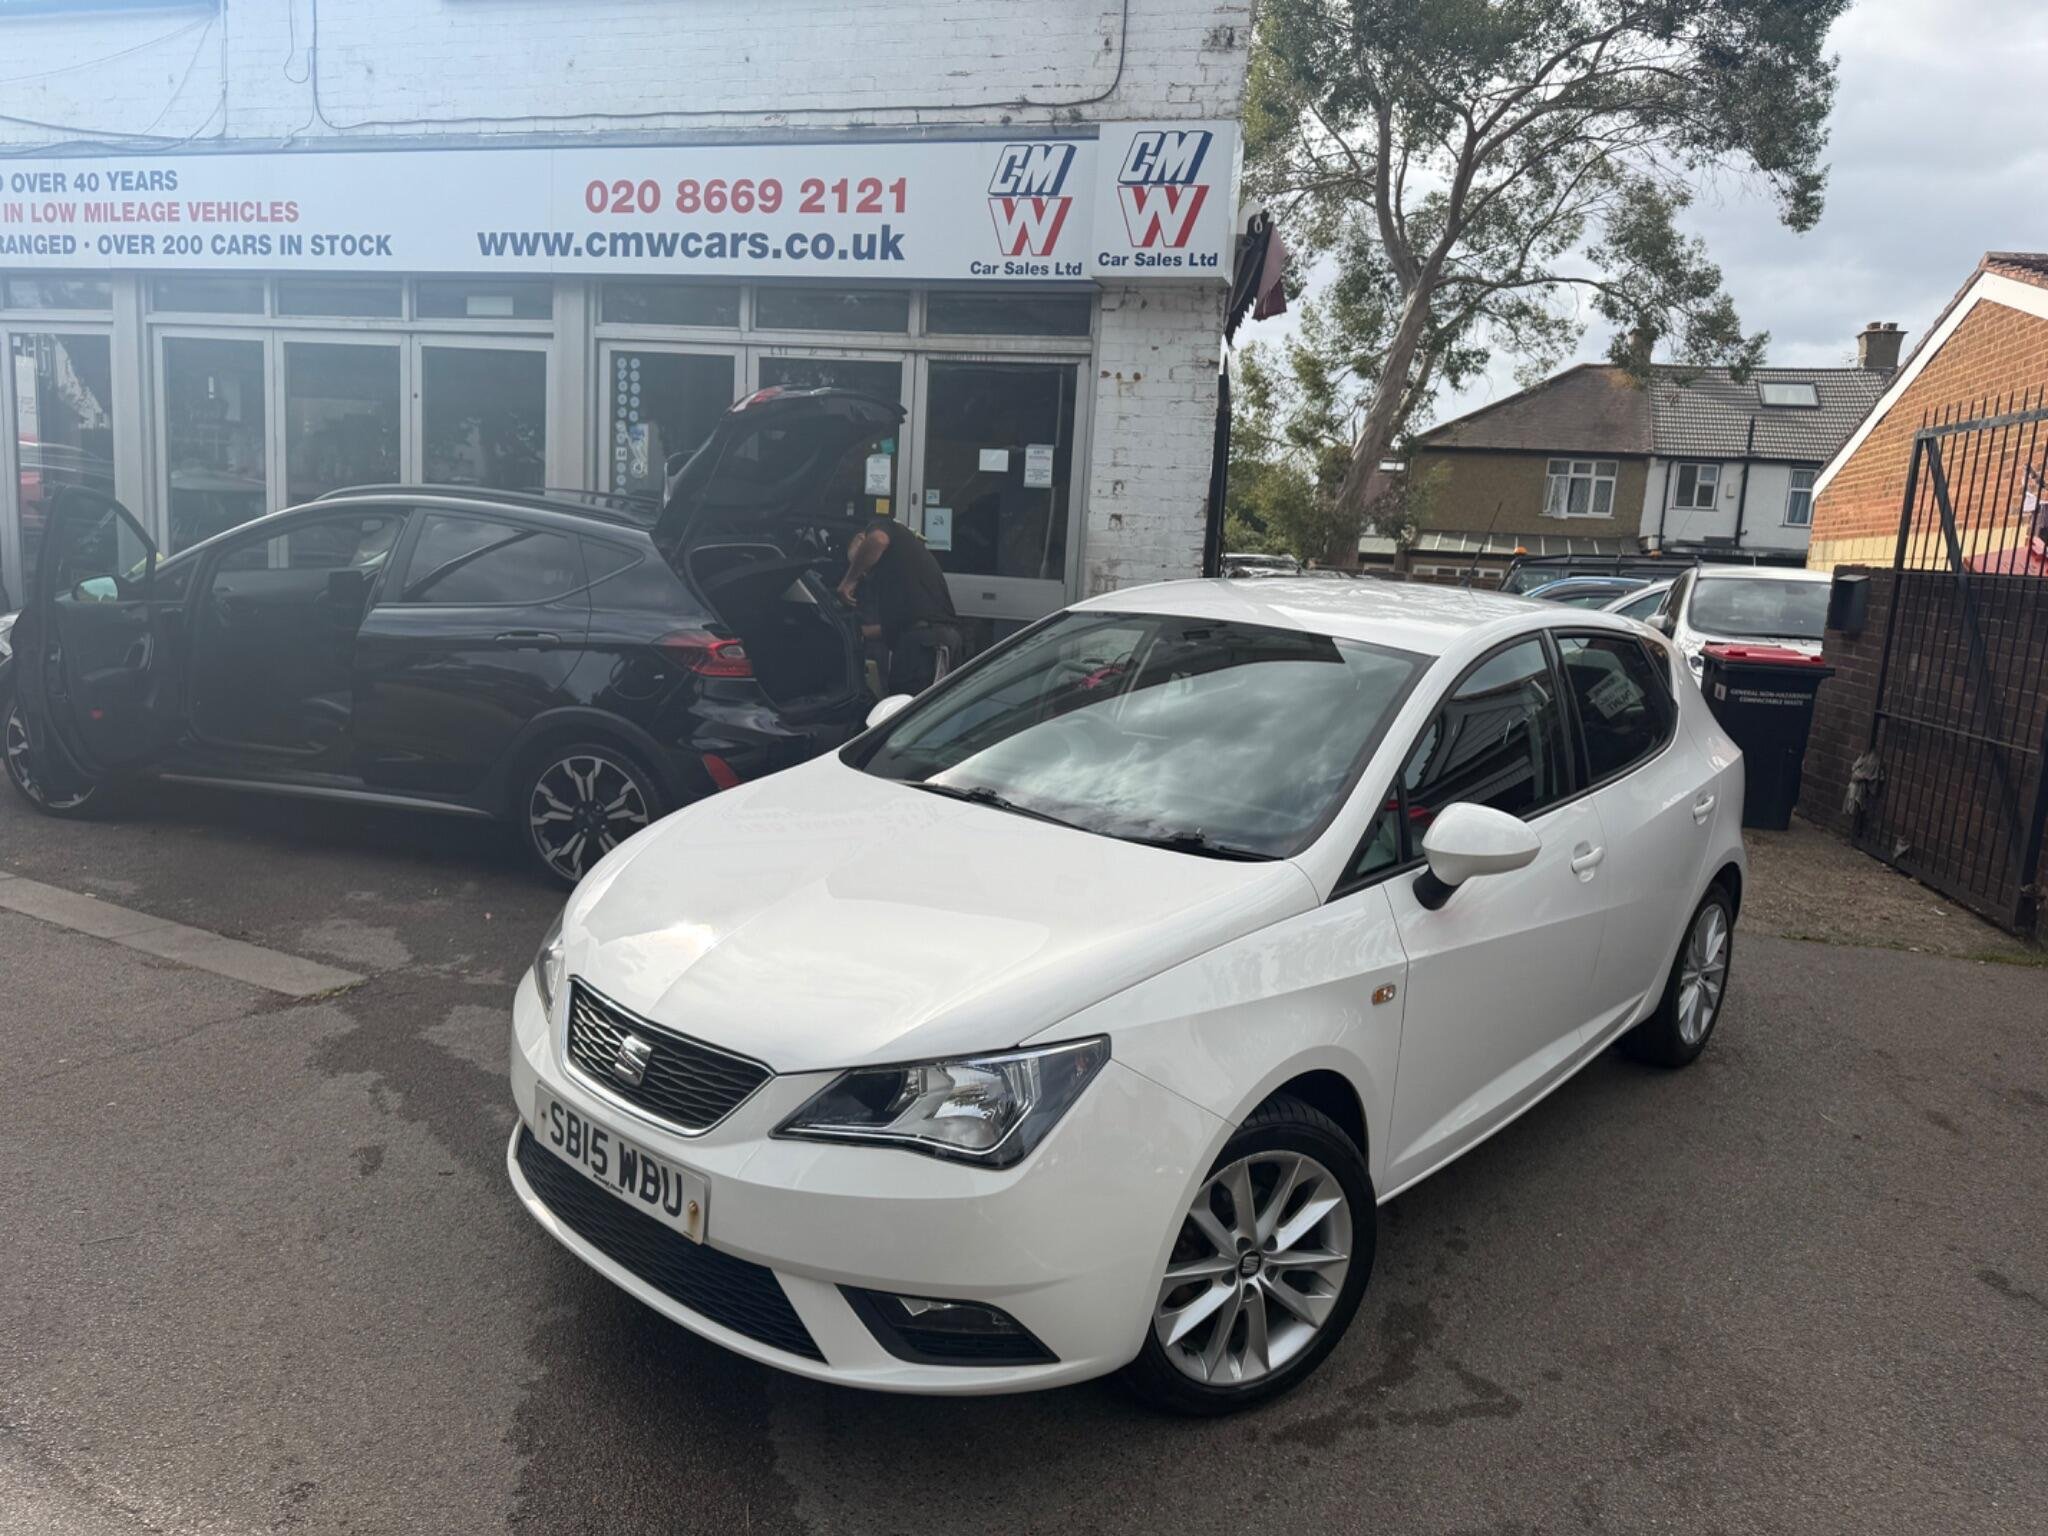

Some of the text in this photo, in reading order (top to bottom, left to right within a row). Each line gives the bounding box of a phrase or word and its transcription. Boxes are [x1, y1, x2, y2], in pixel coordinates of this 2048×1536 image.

[988, 144, 1077, 196] CM
[1117, 130, 1213, 185] CM
[11, 172, 67, 193] OVER
[73, 172, 100, 193] 40
[106, 170, 178, 191] YEARS
[585, 177, 907, 214] 020 8669 2121
[4, 201, 299, 223] IN LOW MILEAGE VEHICLES
[987, 196, 1073, 256] W
[1117, 185, 1210, 248] W
[97, 234, 155, 255] OVER
[162, 235, 203, 255] 200
[211, 234, 272, 255] CARS
[280, 234, 302, 255] IN
[311, 234, 392, 256] STOCK
[477, 224, 905, 261] www.cmwcars.co.uk
[1098, 252, 1218, 267] Car Sales Ltd
[970, 261, 1083, 276] Car Sales Ltd
[550, 1101, 682, 1218] SB15 WBU
